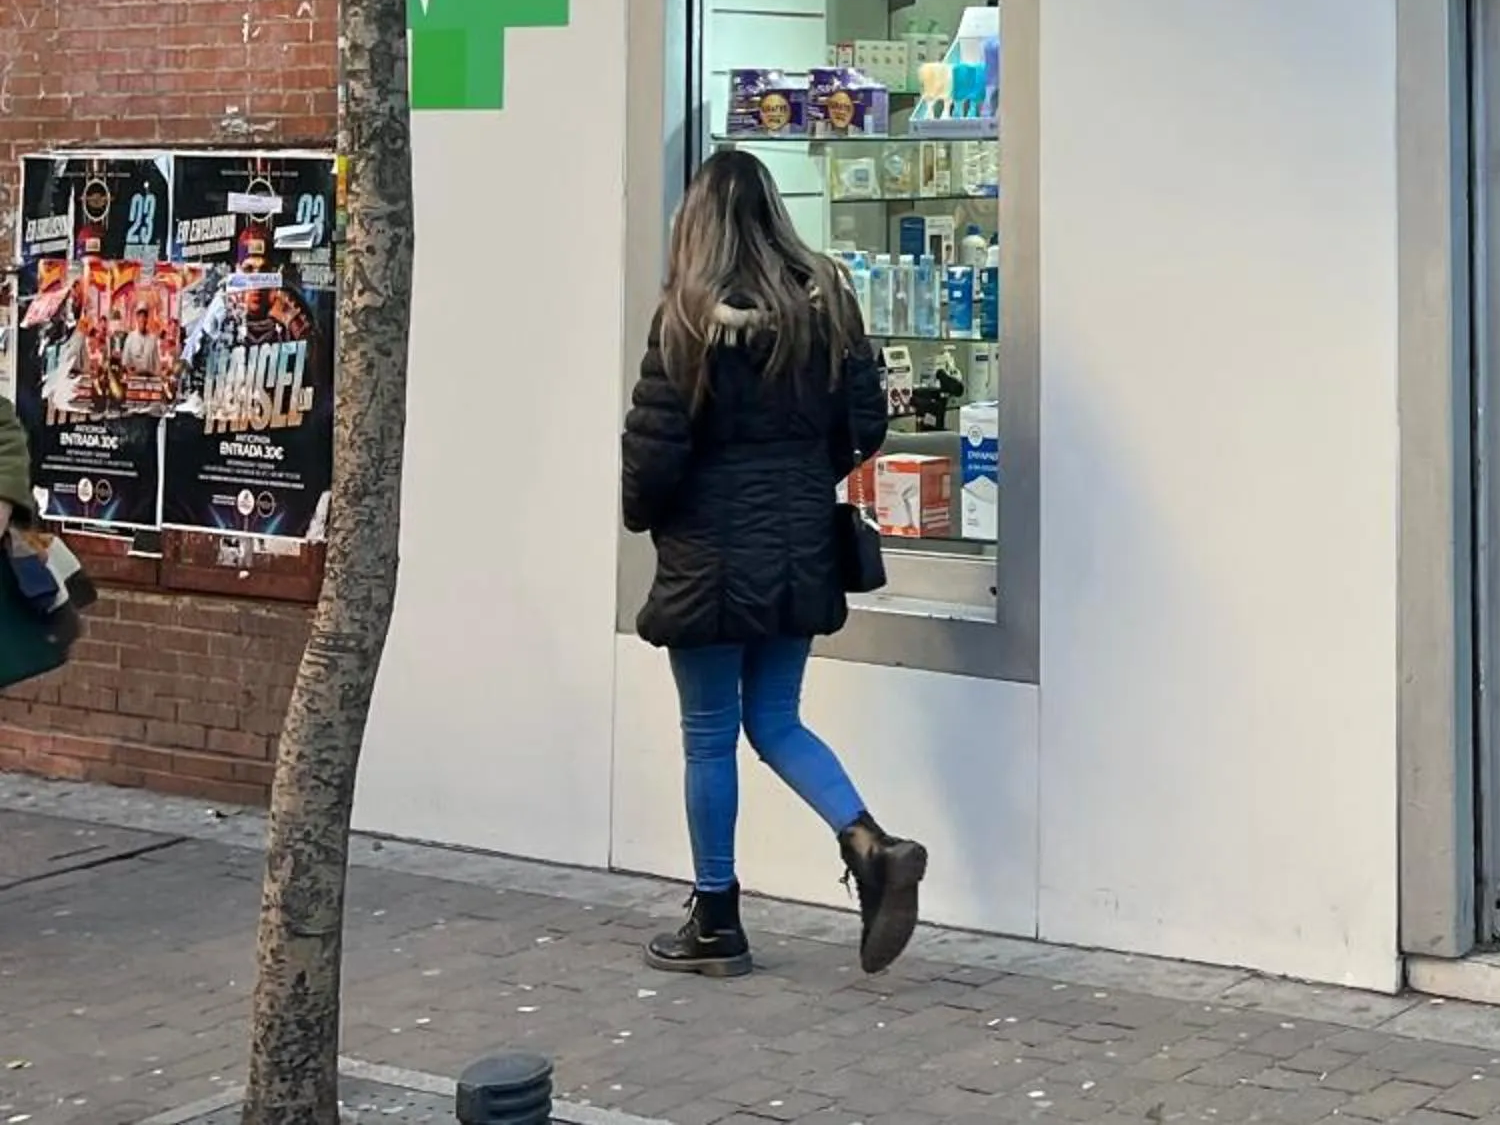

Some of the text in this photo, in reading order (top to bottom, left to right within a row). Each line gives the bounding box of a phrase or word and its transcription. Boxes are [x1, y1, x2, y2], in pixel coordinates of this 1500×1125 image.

[126, 193, 156, 244] 23
[59, 432, 99, 447] ENTRADA
[219, 441, 263, 459] ENTRADA
